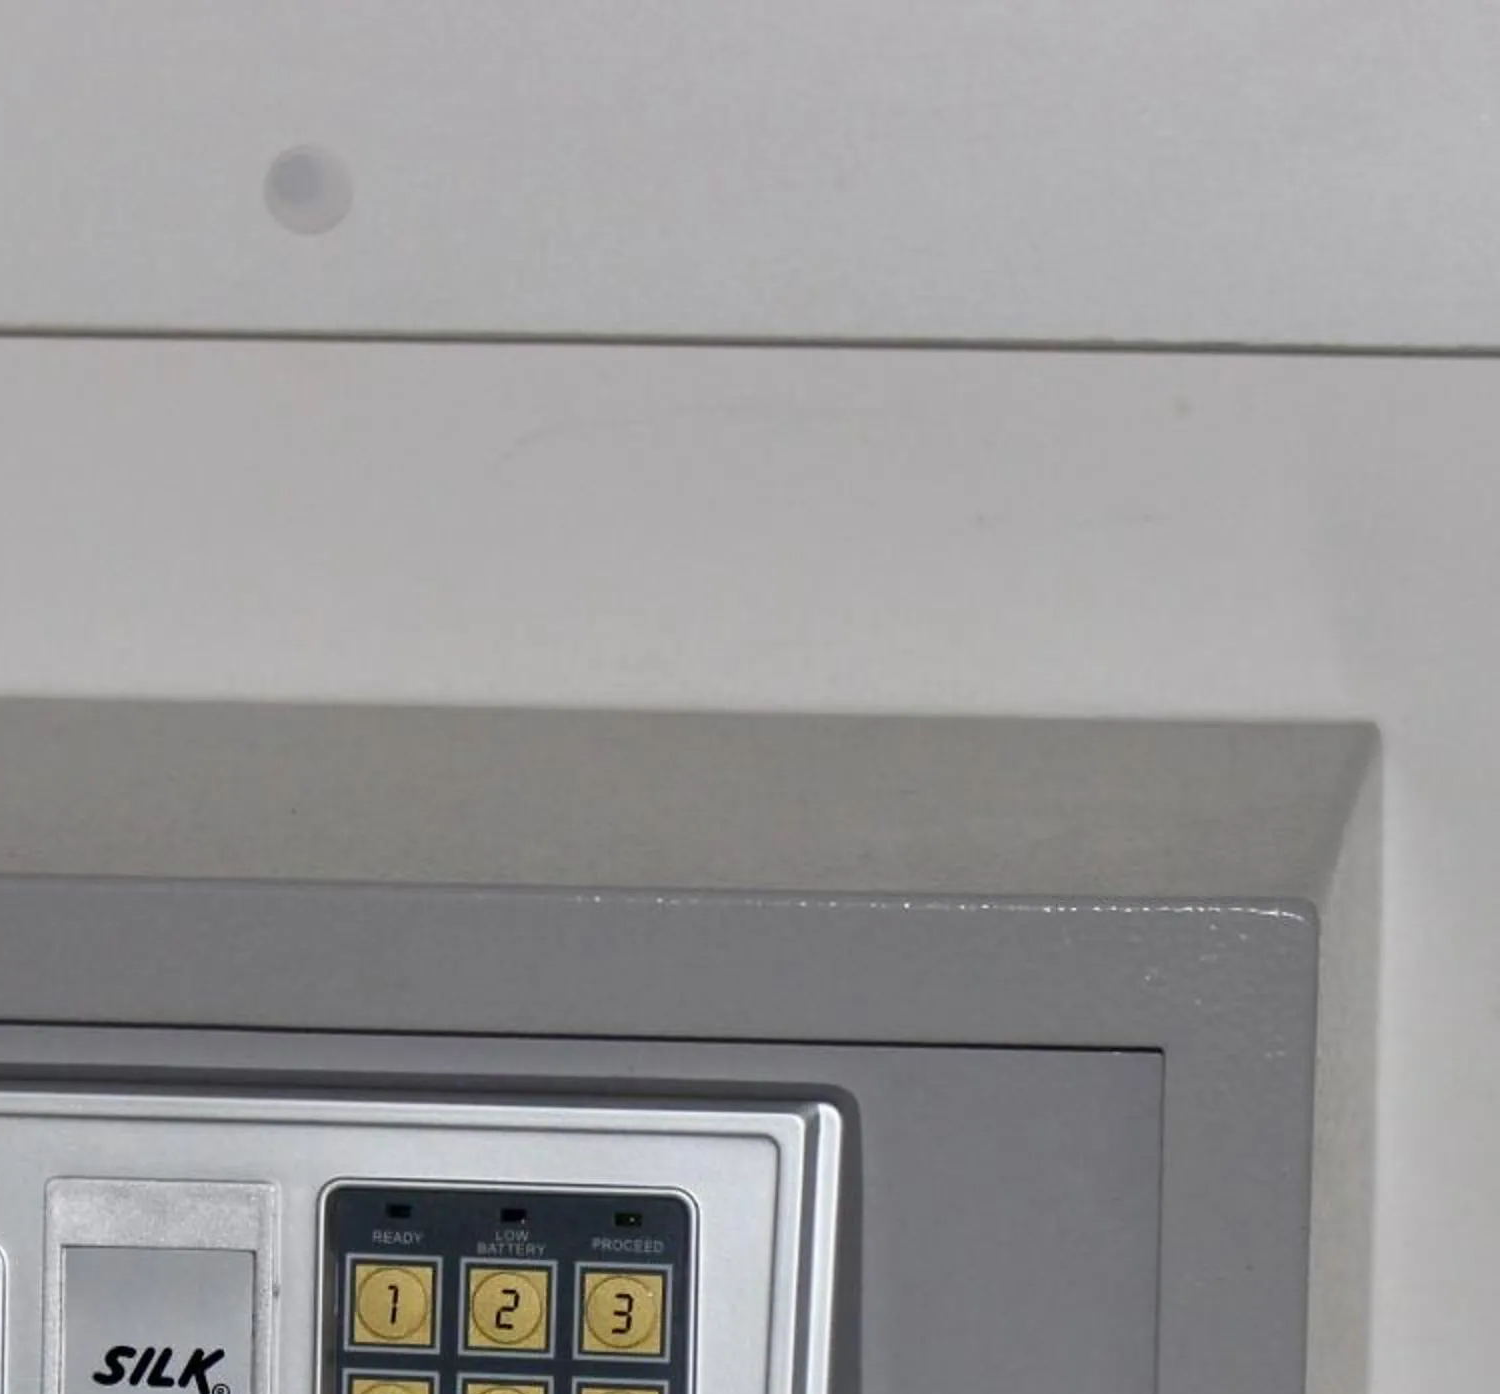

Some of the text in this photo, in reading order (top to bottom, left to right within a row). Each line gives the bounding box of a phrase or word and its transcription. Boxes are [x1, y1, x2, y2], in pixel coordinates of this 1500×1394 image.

[372, 1230, 424, 1244] READY
[495, 1230, 530, 1243] LOW
[476, 1241, 547, 1257] BATTERY
[591, 1237, 665, 1254] PROCEED
[388, 1285, 399, 1325] 1
[495, 1289, 520, 1330] 2
[611, 1293, 635, 1335] 3
